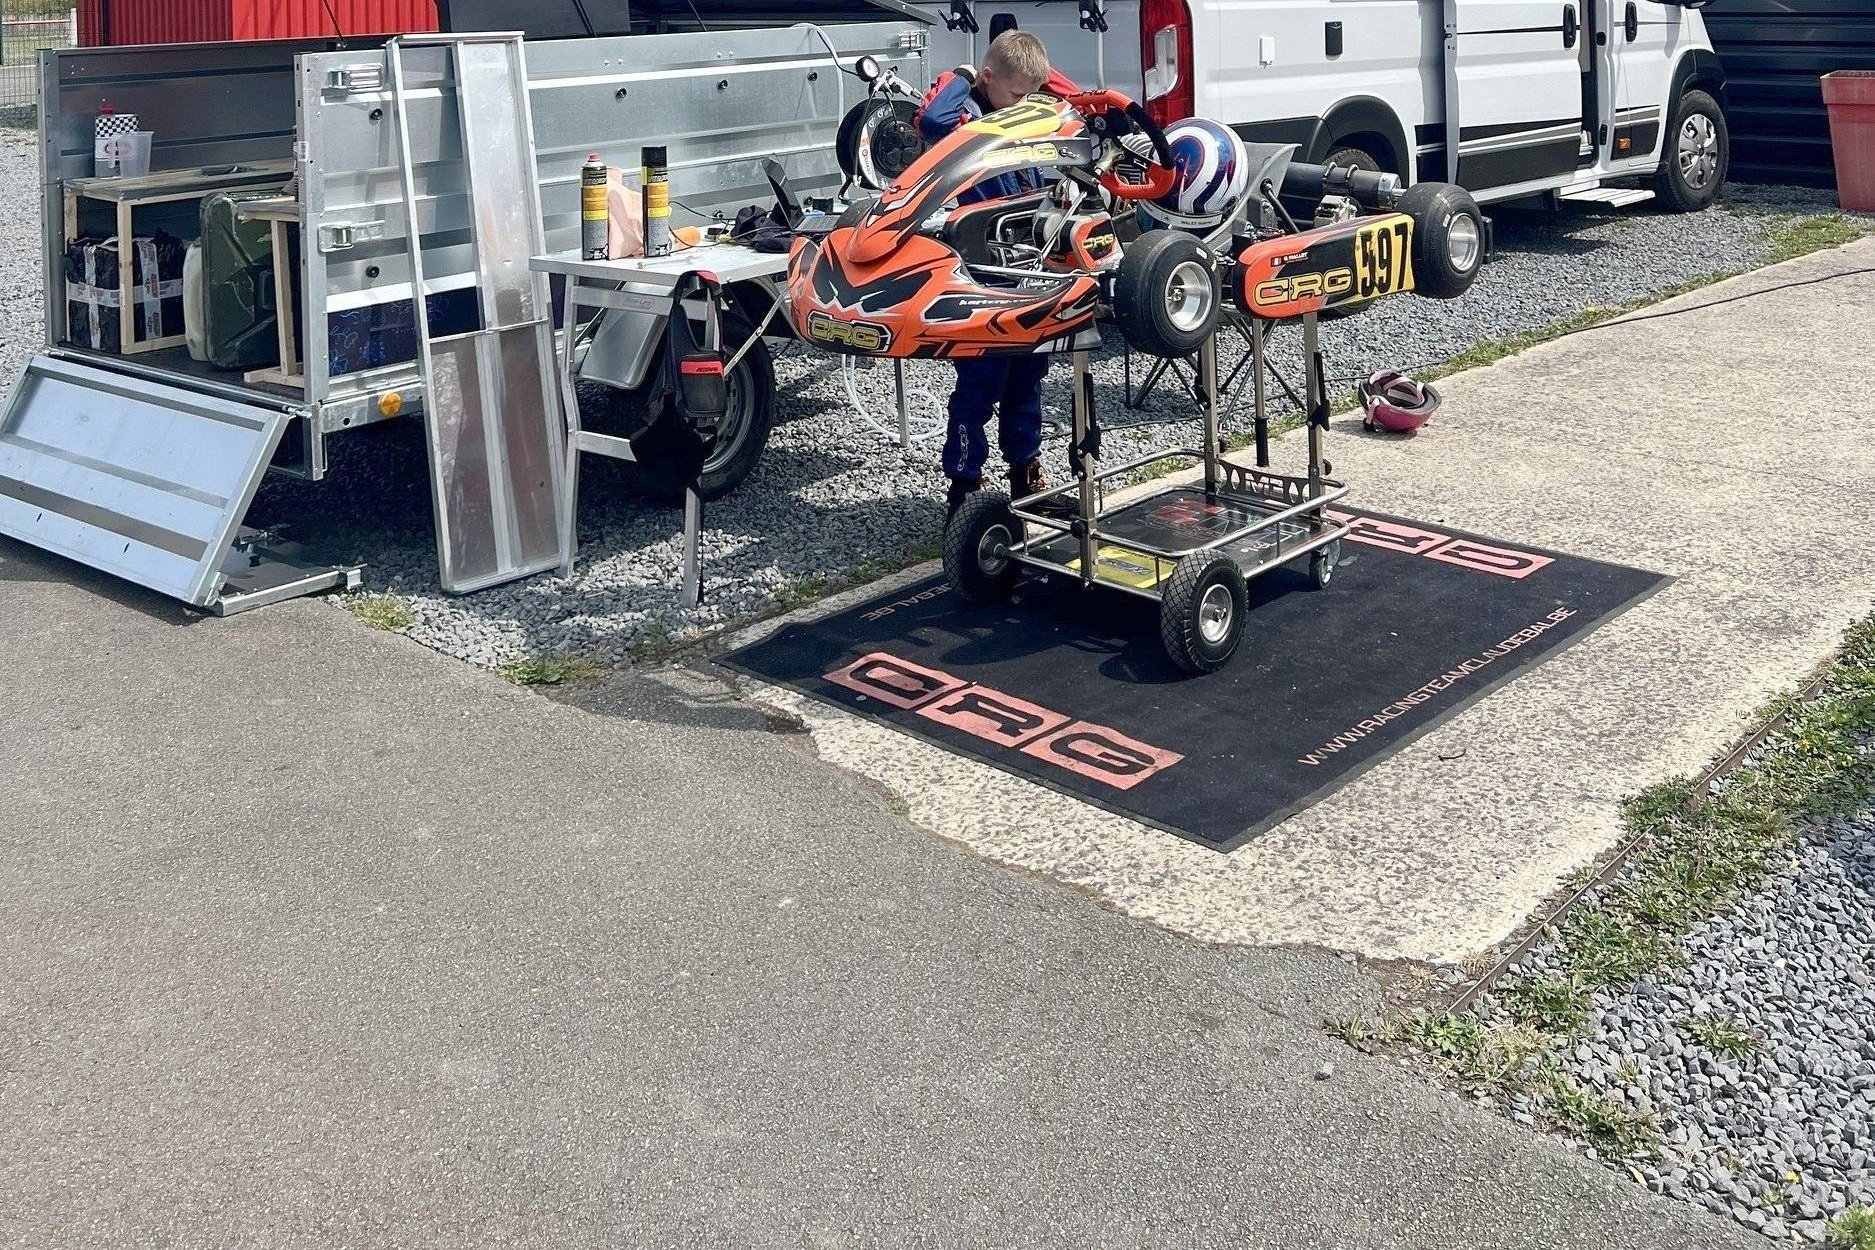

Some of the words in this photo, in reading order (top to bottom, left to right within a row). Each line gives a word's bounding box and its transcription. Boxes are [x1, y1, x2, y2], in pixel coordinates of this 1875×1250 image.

[1081, 233, 1115, 250] CRG
[1360, 221, 1408, 298] 597
[1254, 268, 1353, 306] CRG
[810, 318, 881, 349] CRG
[840, 658, 1166, 780] CRG
